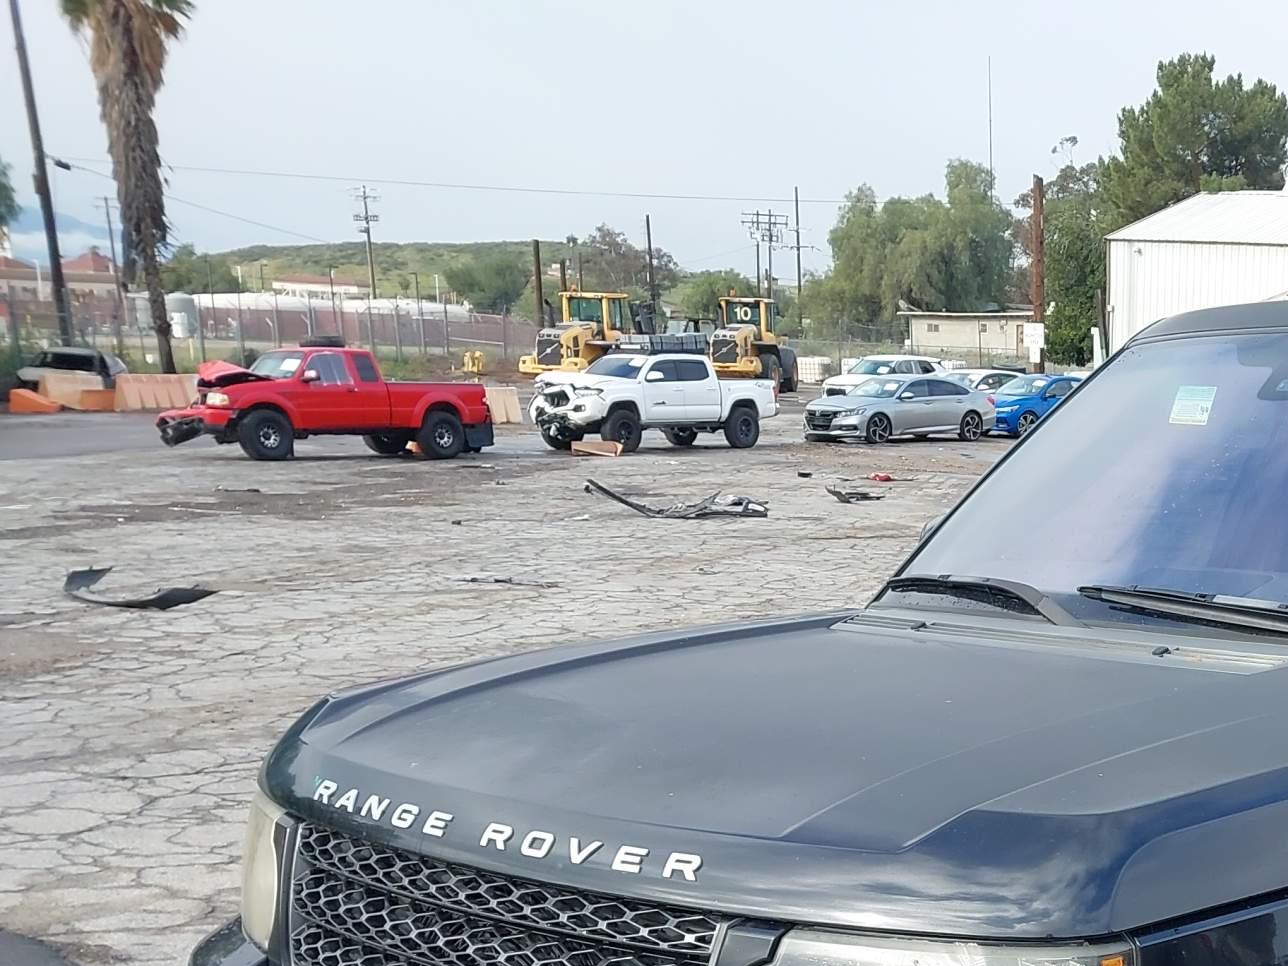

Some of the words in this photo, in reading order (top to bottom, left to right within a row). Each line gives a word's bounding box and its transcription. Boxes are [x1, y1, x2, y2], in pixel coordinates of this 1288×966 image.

[733, 306, 752, 321] 10
[312, 778, 453, 838] RANGE
[479, 821, 703, 881] ROVER
